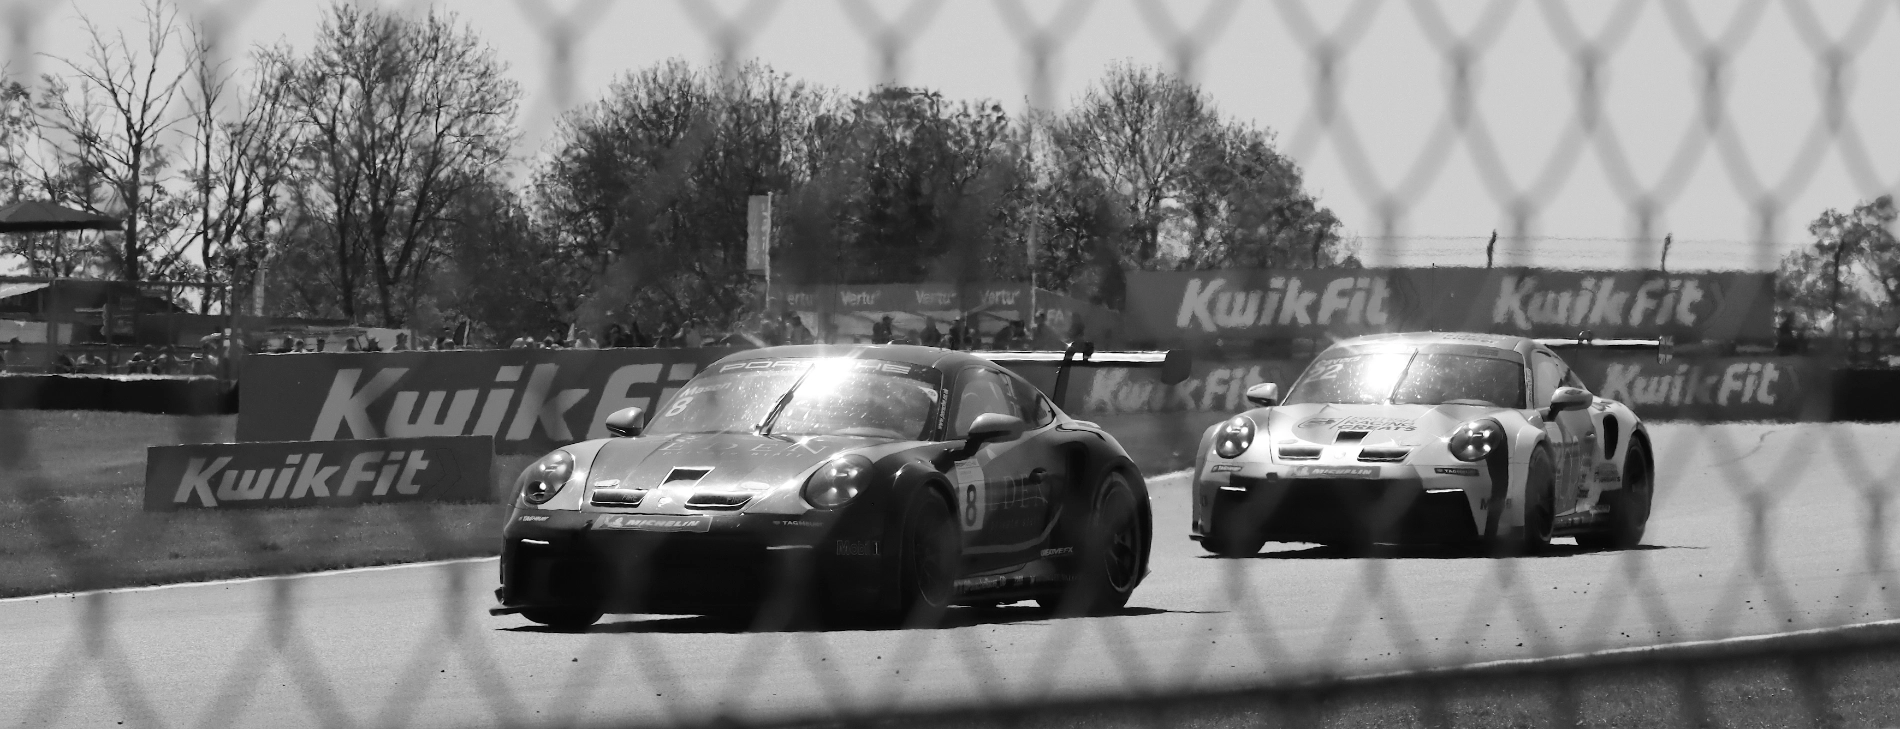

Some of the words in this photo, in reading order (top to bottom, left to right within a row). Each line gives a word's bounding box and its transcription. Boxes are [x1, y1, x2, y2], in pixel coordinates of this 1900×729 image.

[786, 292, 814, 306] ertu
[719, 359, 912, 375] PORHE
[679, 381, 732, 398] Mason
[309, 362, 698, 442] KwikFi
[664, 395, 694, 418] 8
[173, 449, 430, 508] KwikFit
[965, 483, 977, 527] 8
[625, 519, 701, 528] MICHELIN
